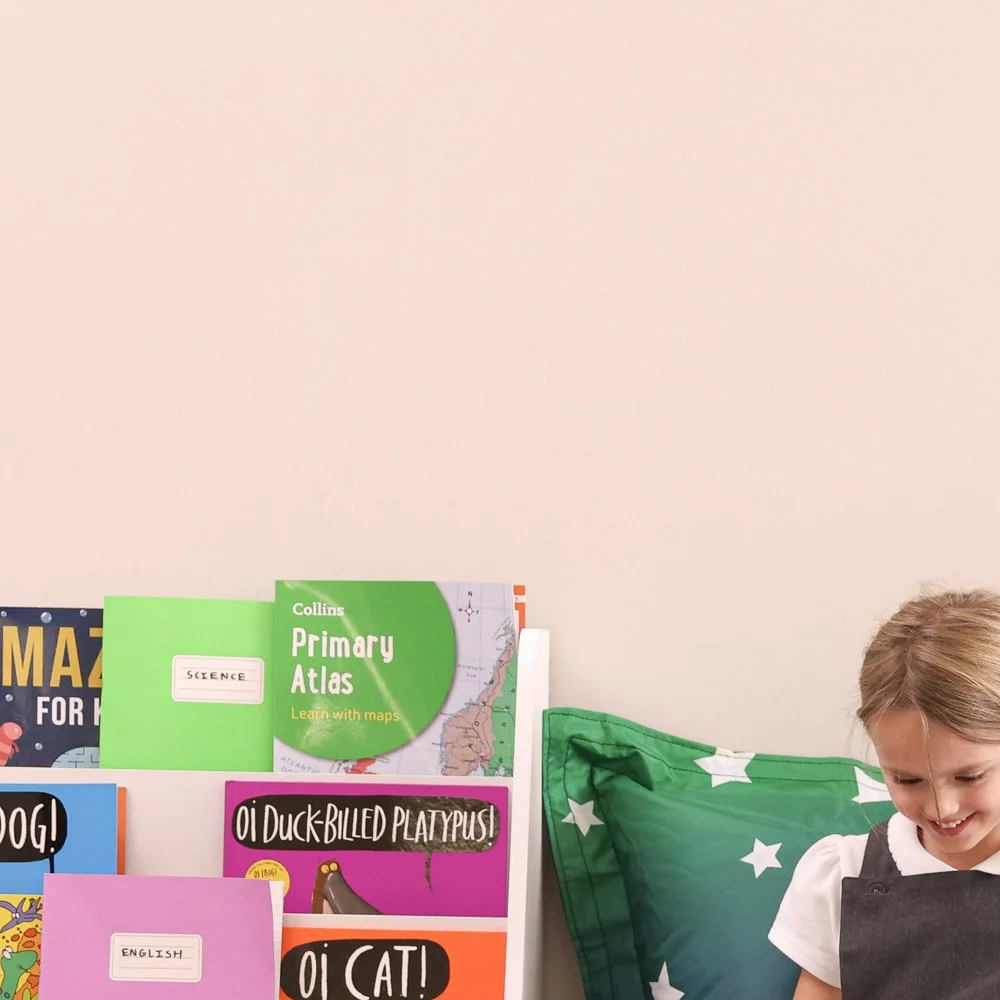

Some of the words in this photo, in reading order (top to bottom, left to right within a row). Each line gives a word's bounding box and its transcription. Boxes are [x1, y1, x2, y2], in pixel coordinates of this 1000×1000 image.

[292, 602, 344, 616] Collins
[292, 627, 394, 663] Primary
[186, 670, 246, 681] SCIENCE
[290, 664, 354, 694] Atlas
[36, 696, 84, 726] FOR
[291, 708, 329, 720] Learn
[333, 709, 361, 721] with
[364, 711, 400, 723] maps
[392, 804, 495, 847] PLATYPUS!
[122, 948, 182, 959] ENGLISH
[345, 944, 427, 1000] CAT!
